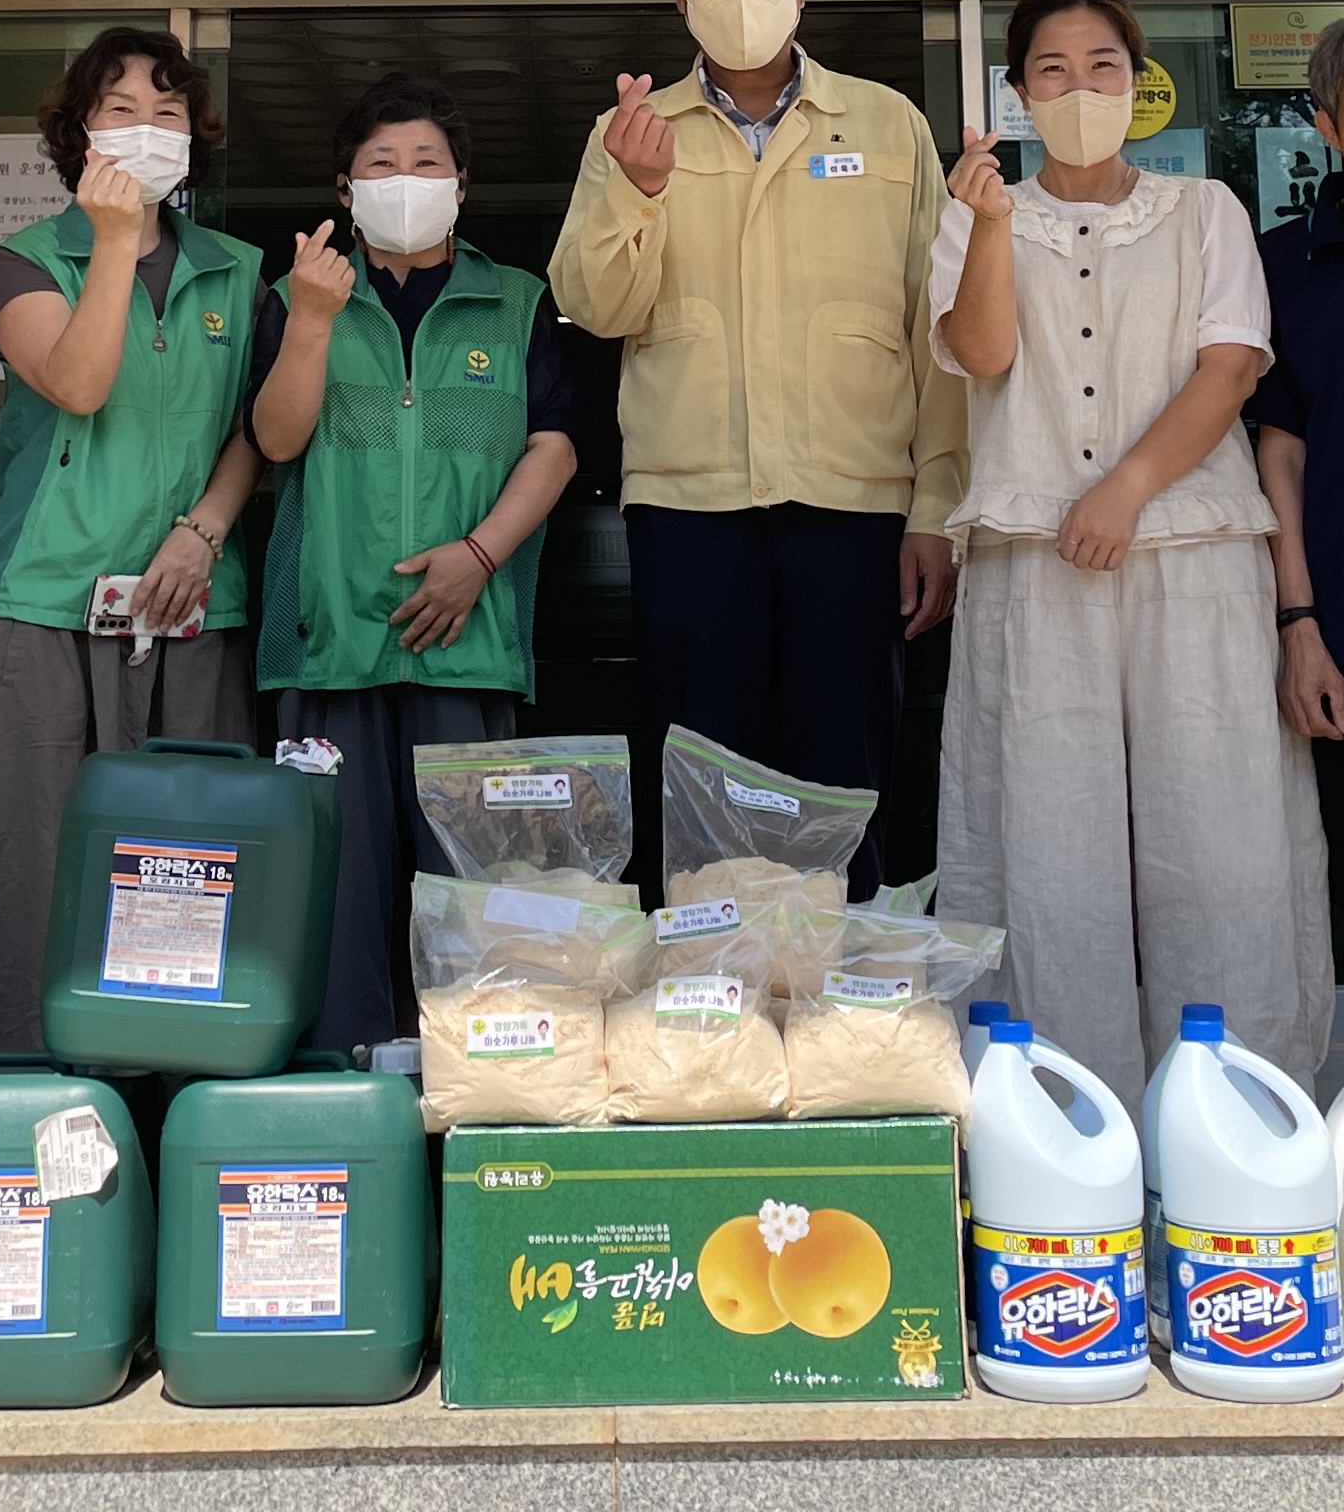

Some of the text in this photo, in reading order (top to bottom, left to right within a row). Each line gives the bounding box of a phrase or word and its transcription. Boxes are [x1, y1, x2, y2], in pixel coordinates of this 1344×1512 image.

[1136, 90, 1171, 104] 방역
[464, 372, 494, 384] SMU
[138, 857, 206, 878] 유한락스
[247, 1183, 318, 1203] 유한락스
[509, 1253, 573, 1312] 배
[611, 1300, 666, 1332] 명품
[1001, 1277, 1116, 1341] 유한락스
[1189, 1275, 1304, 1340] 유한락스
